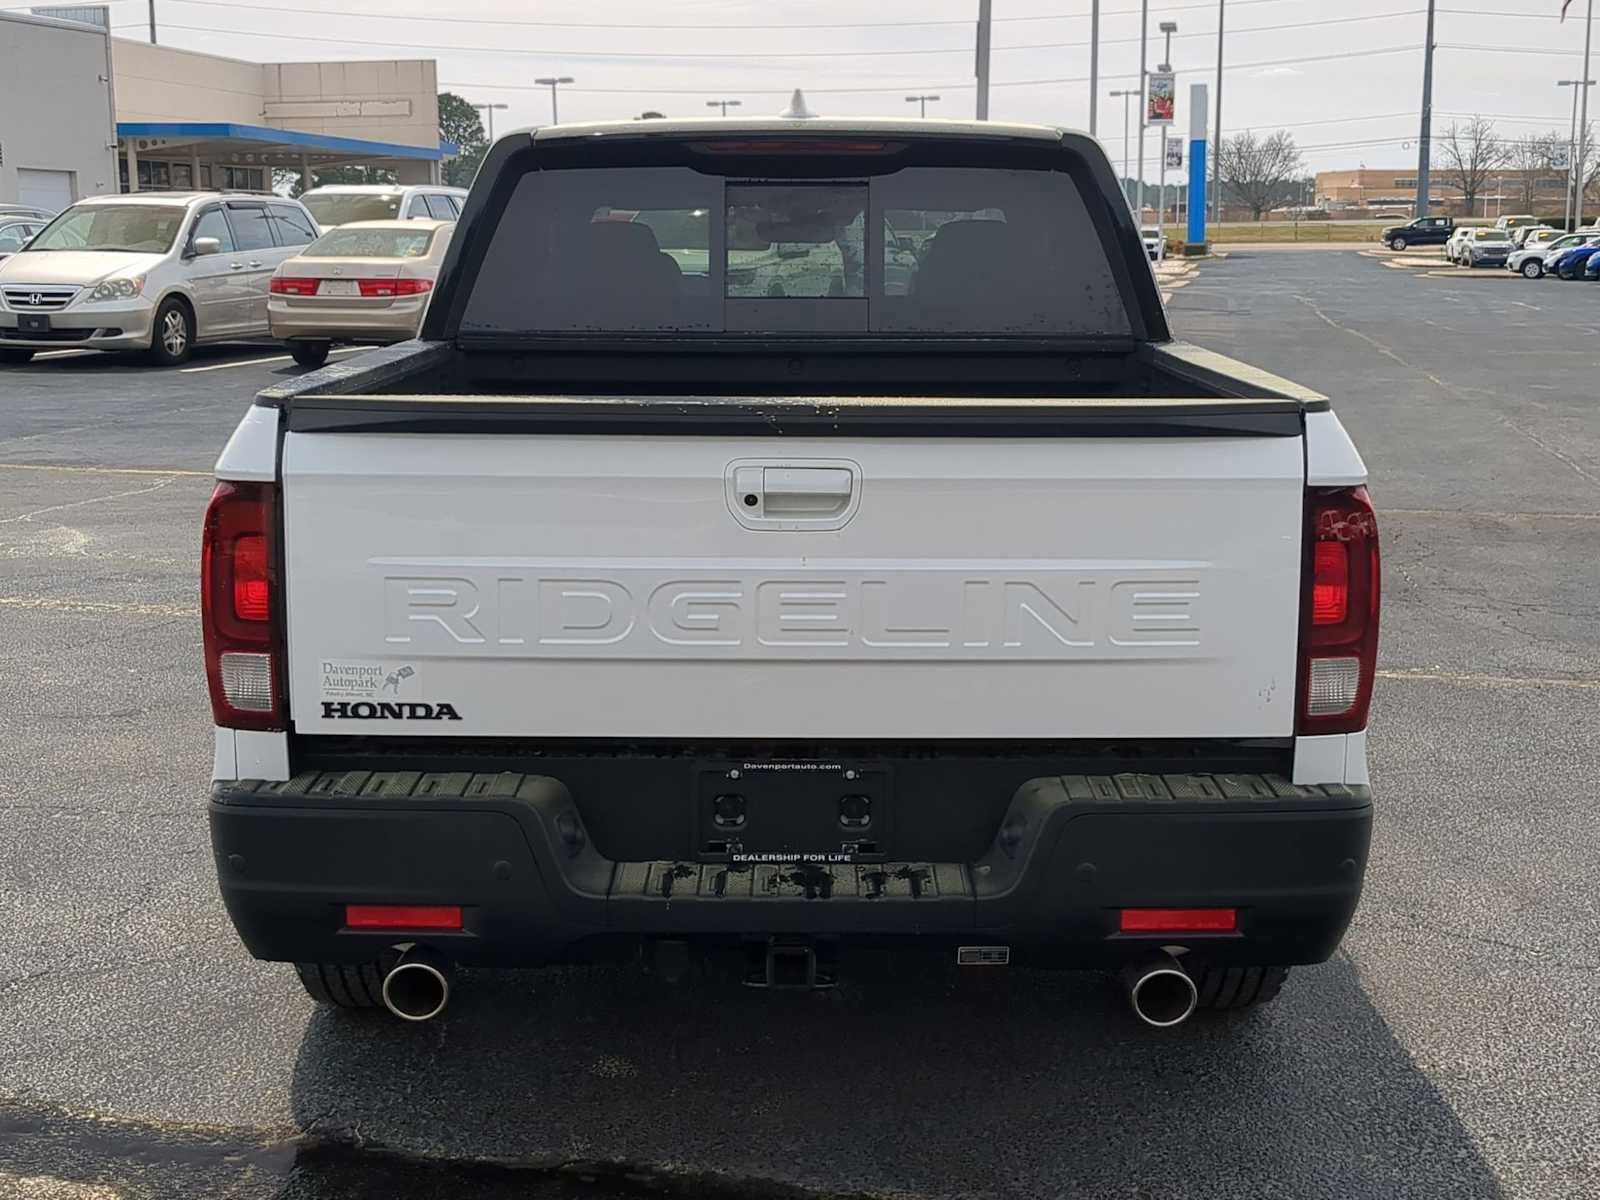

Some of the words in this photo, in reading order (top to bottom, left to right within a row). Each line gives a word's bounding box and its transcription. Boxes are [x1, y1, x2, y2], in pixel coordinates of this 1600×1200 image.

[383, 576, 1201, 646] RIDGELINE
[322, 662, 383, 677] Davenport
[322, 675, 378, 689] Autopark
[321, 701, 463, 720] HONDA
[743, 762, 841, 771] Davenportauto.com
[732, 854, 801, 862] DEALERSHIP
[803, 854, 825, 862] FOR
[828, 854, 852, 862] LIFE
